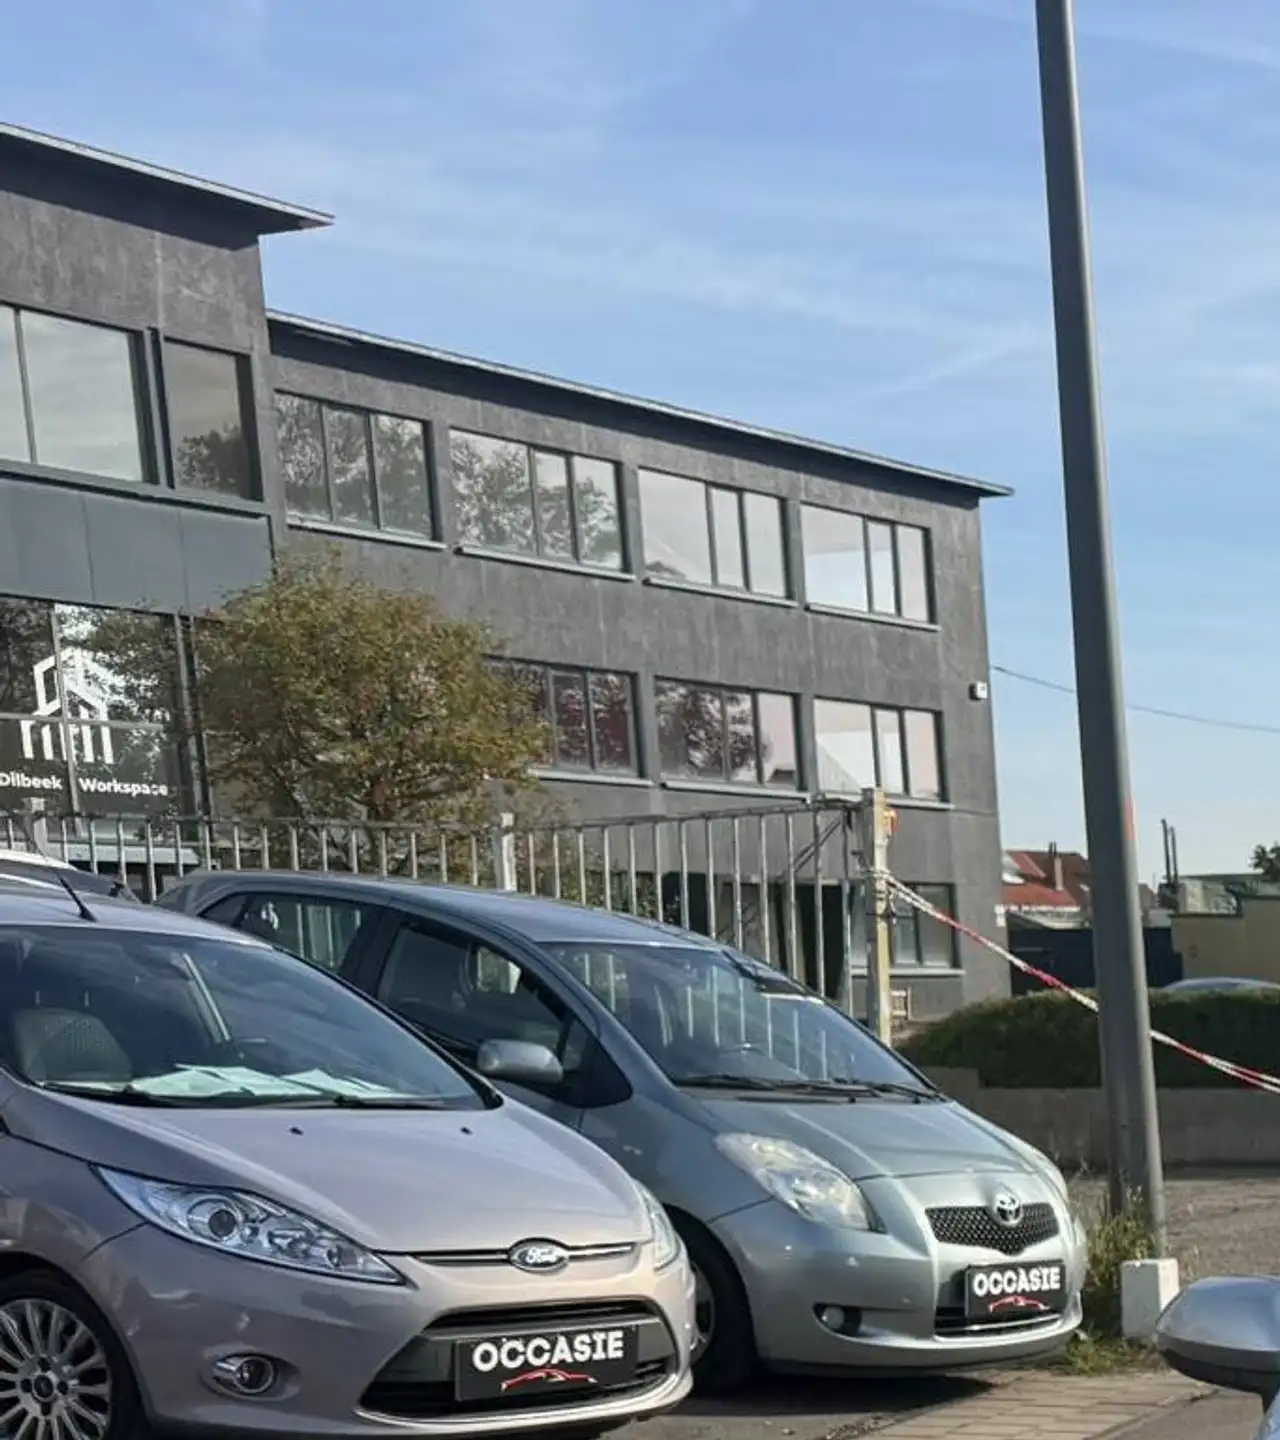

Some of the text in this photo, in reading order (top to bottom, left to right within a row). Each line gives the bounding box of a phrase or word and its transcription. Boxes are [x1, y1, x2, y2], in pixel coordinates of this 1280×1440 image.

[0, 772, 169, 798] Dilbeek Workspace
[972, 1266, 1061, 1297] OCCASIE
[472, 1330, 624, 1372] OCCASIE
